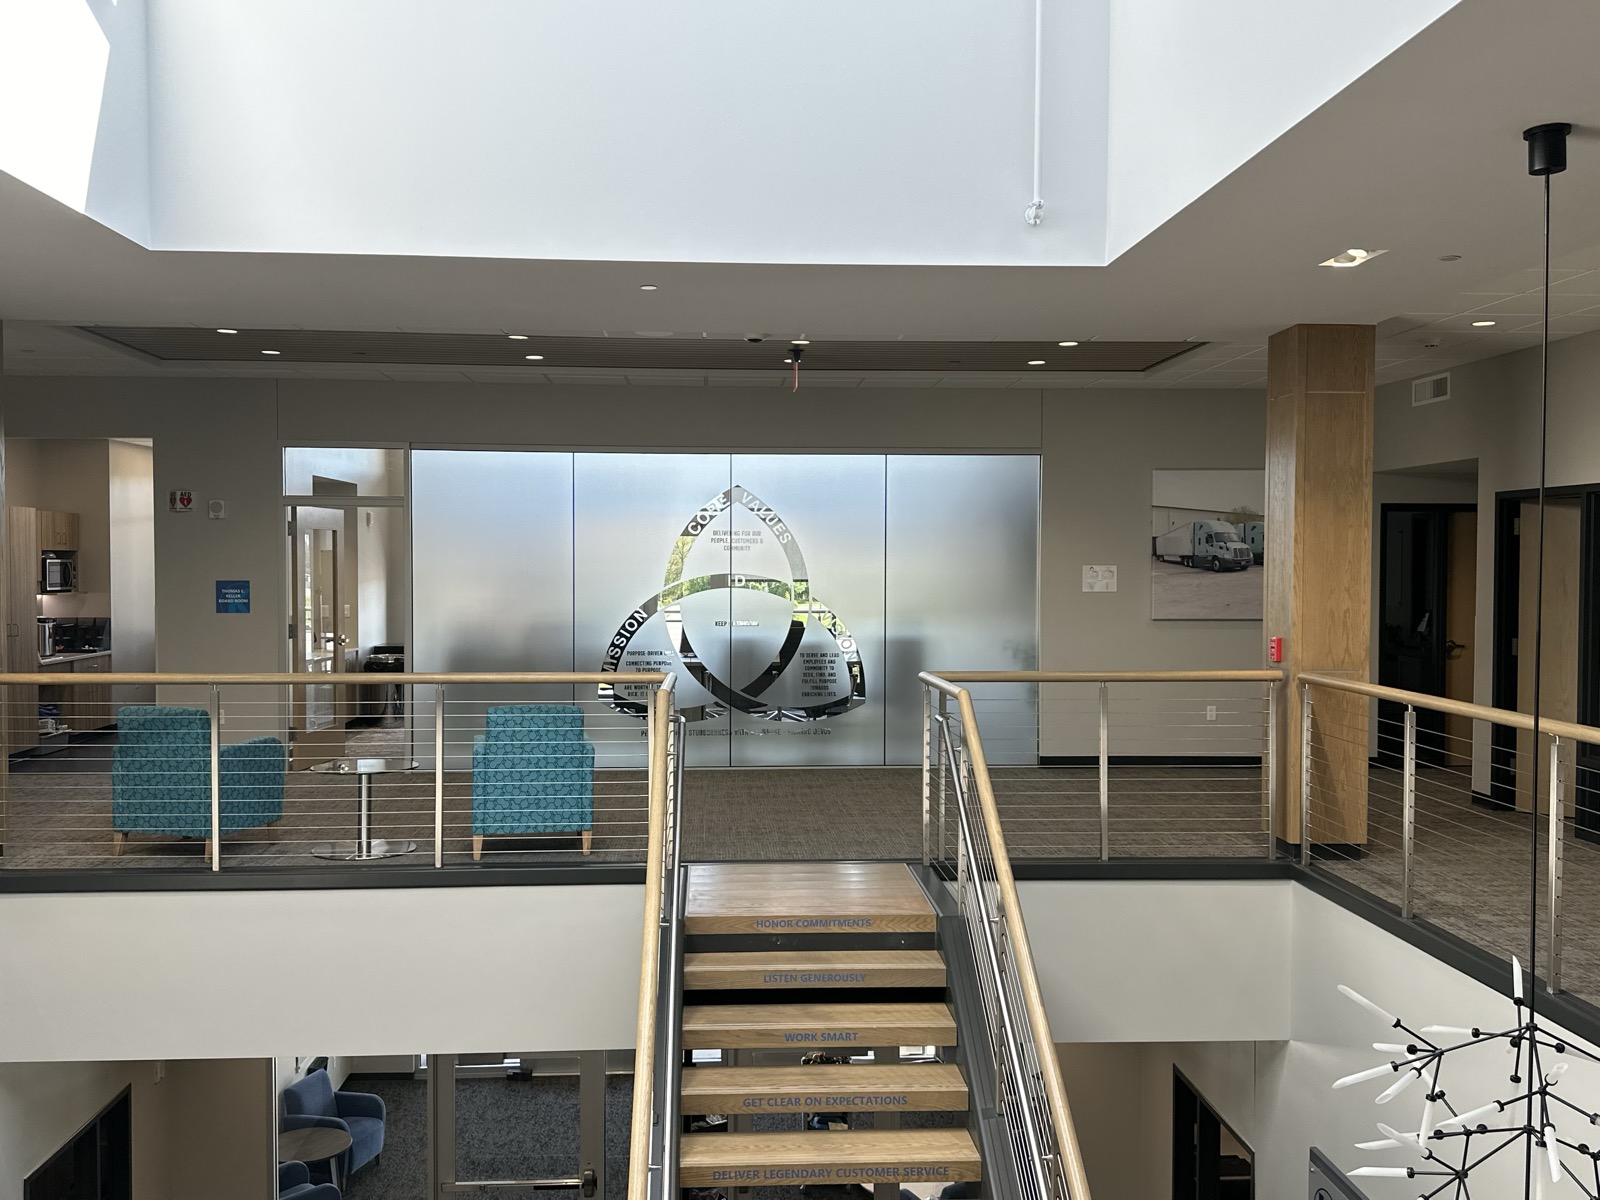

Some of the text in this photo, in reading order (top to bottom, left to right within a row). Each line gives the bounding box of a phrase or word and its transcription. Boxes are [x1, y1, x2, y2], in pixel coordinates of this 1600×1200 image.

[687, 491, 792, 544] CORE VALUES
[688, 729, 733, 737] STUBBORNNES
[755, 918, 872, 929] HONOR COMMITMENTS
[763, 973, 867, 984] LISTEN GENEROUSLY
[784, 1032, 859, 1042] WORK SMART
[742, 1096, 908, 1108] GET CLEAR ON EXPECTATIONS
[712, 1166, 950, 1181] DELIVER LEGENDARY CUSTOMER SERVICE
